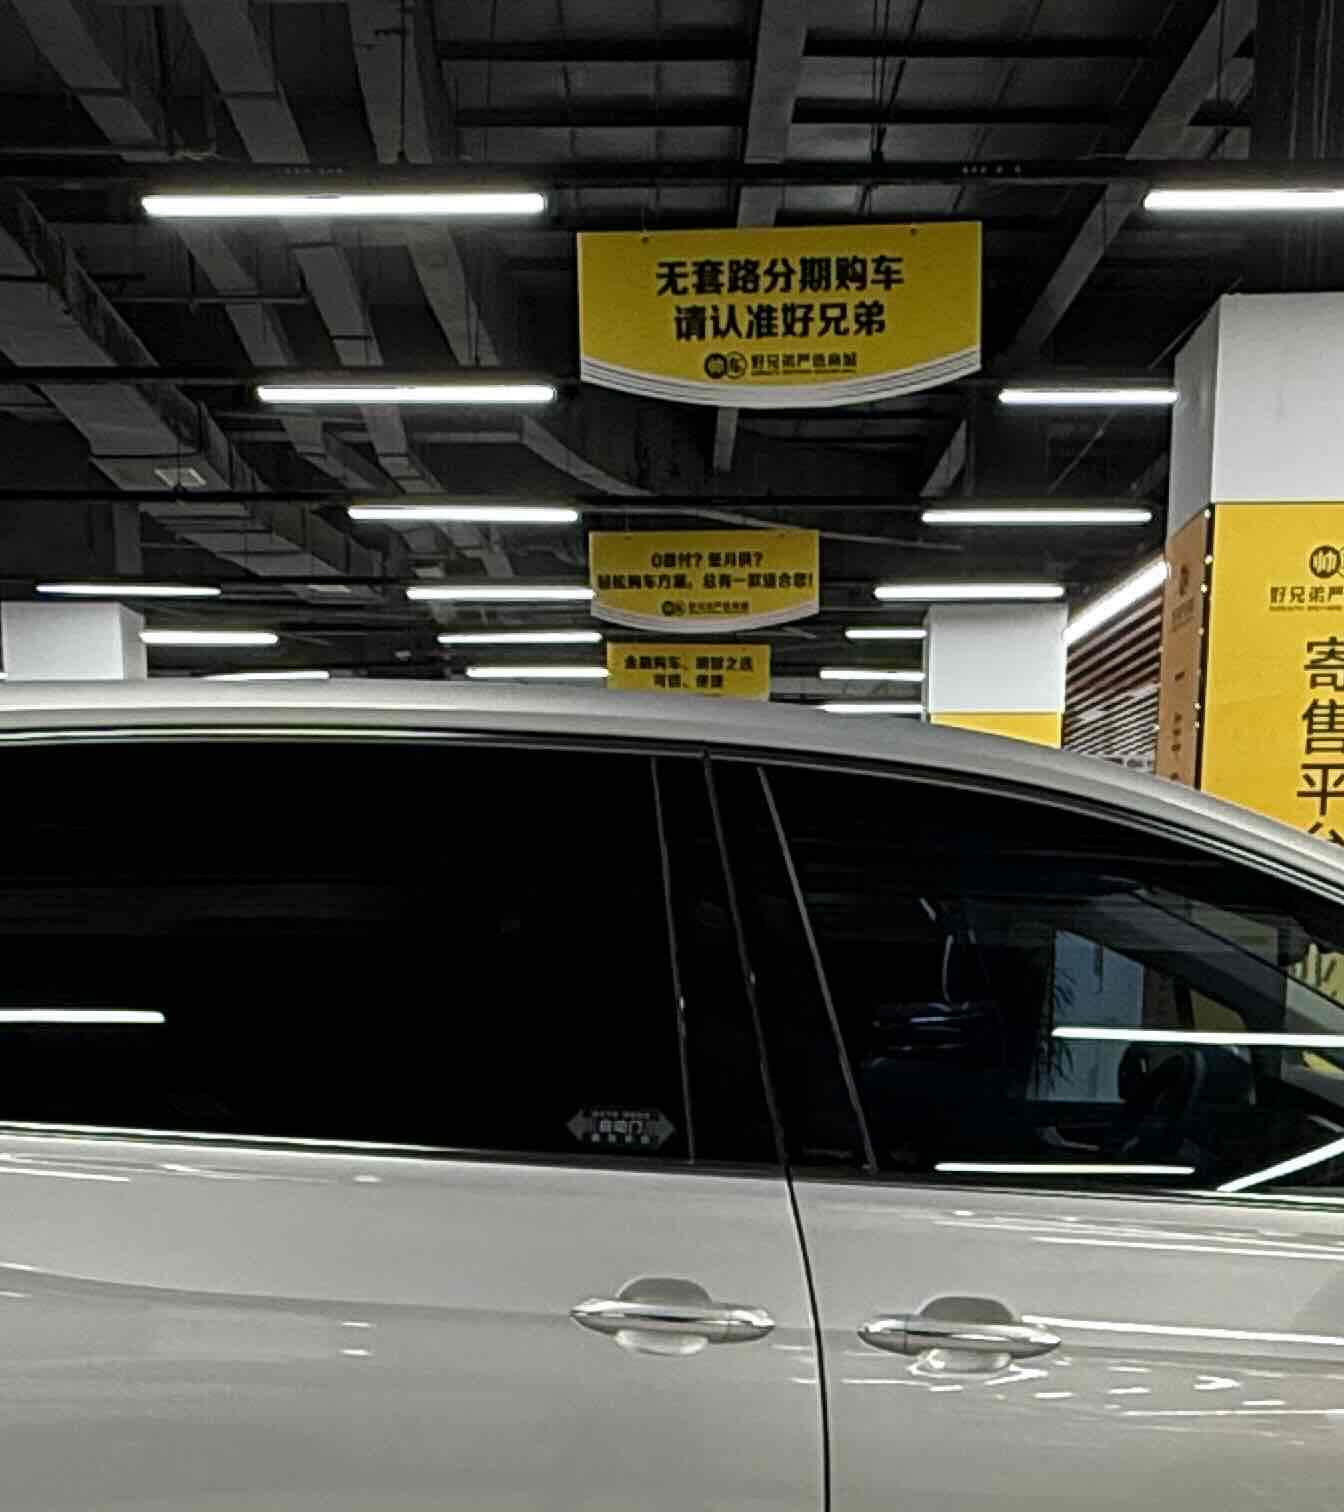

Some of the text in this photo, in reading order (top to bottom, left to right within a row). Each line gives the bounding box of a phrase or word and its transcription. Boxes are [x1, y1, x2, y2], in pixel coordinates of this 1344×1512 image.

[656, 255, 904, 295] 无套路分期购车
[673, 300, 886, 341] 请认准好兄弟
